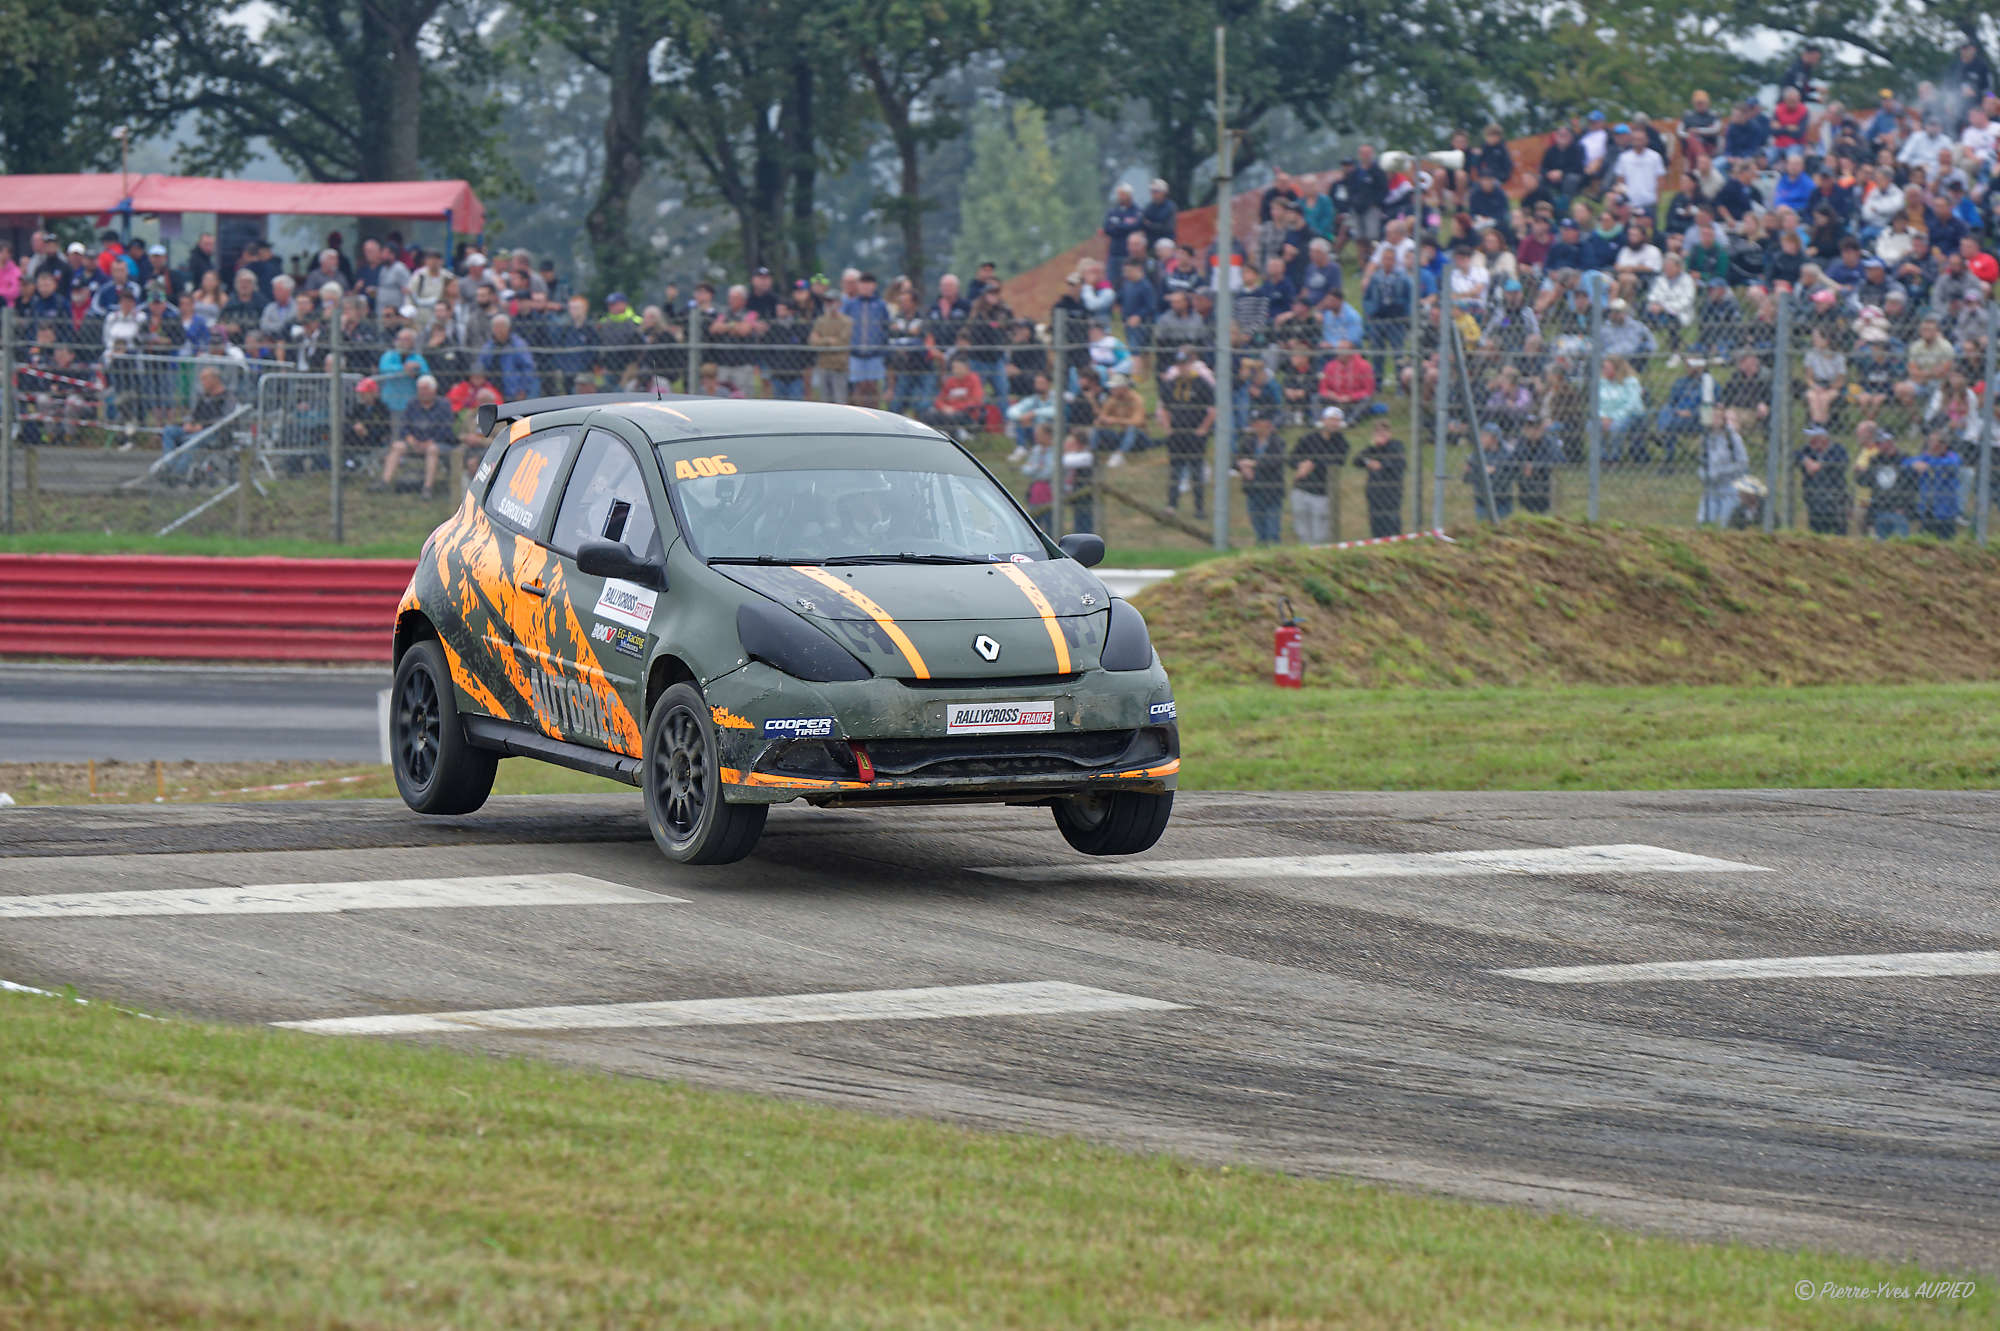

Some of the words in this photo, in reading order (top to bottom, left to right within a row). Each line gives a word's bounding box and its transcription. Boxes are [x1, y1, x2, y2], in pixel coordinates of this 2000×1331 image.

[509, 448, 548, 505] 406
[675, 454, 738, 479] 406
[605, 586, 638, 612] RALLYCROSS
[764, 718, 832, 730] COOPER
[954, 708, 1020, 724] RALLYCROSS
[1019, 711, 1053, 724] FRANCE
[794, 727, 830, 736] TIRES
